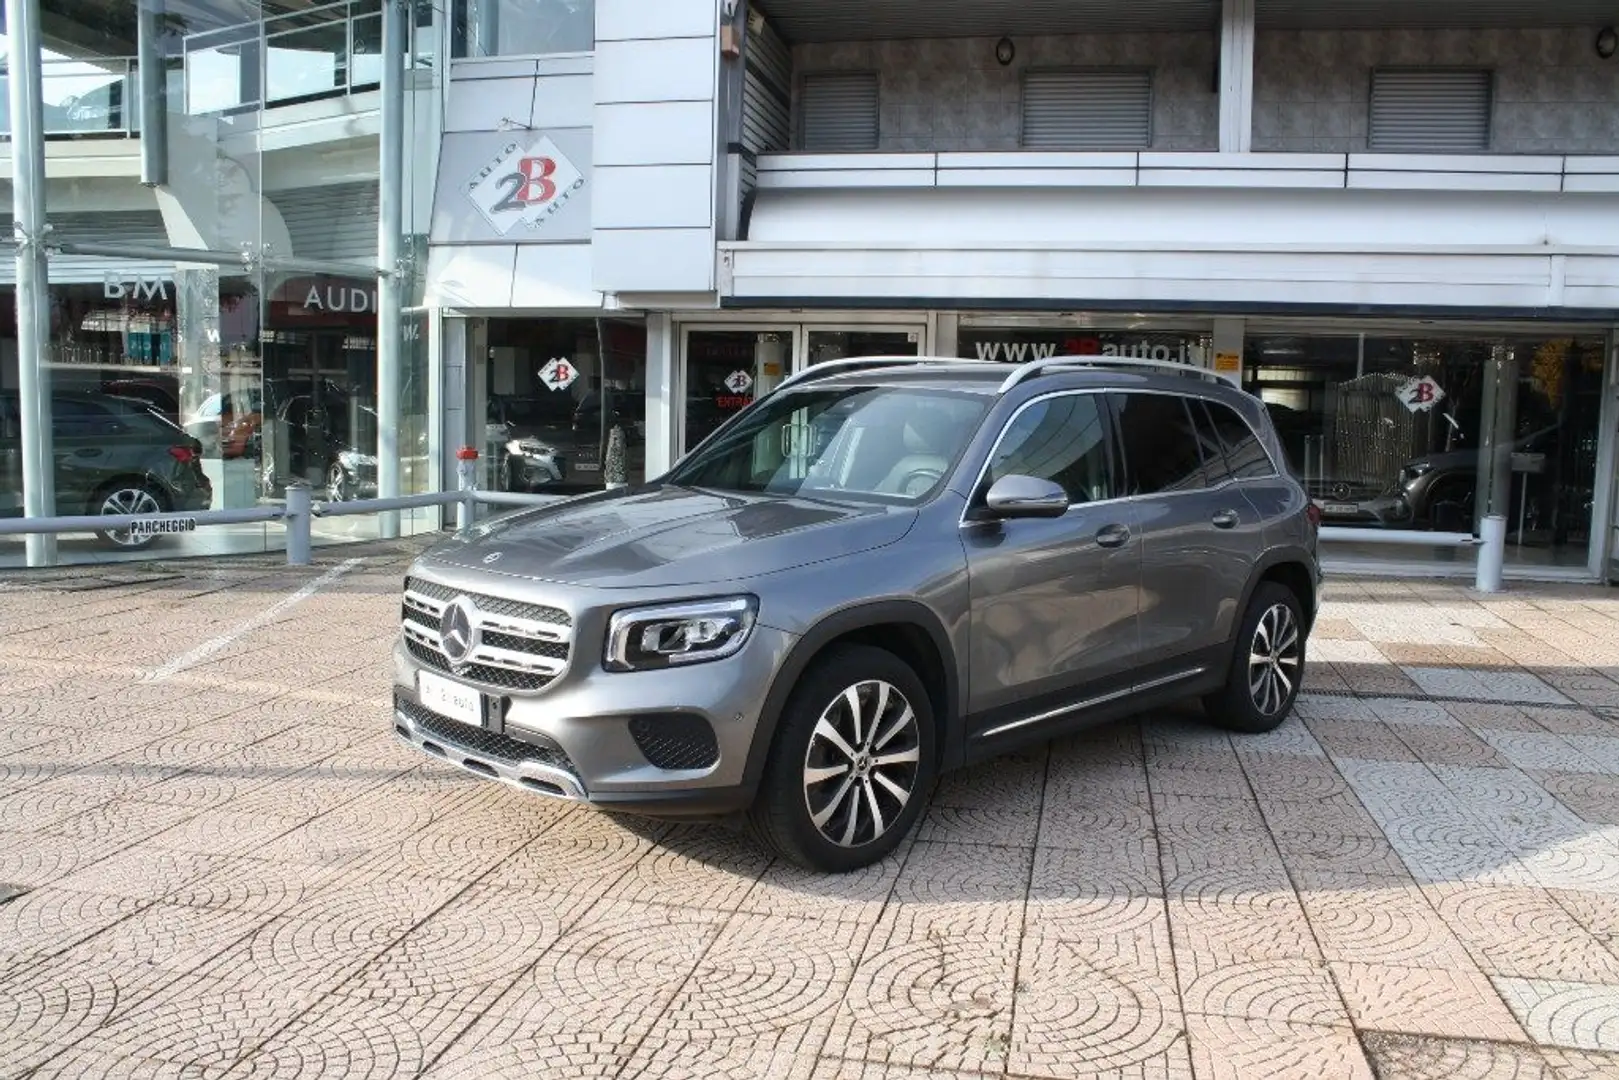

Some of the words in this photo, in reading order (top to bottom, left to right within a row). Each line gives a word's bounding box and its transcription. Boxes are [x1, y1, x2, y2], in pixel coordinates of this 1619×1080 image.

[490, 156, 556, 214] 2B
[303, 285, 378, 314] AUDI
[131, 518, 196, 534] PARCHEGGIO
